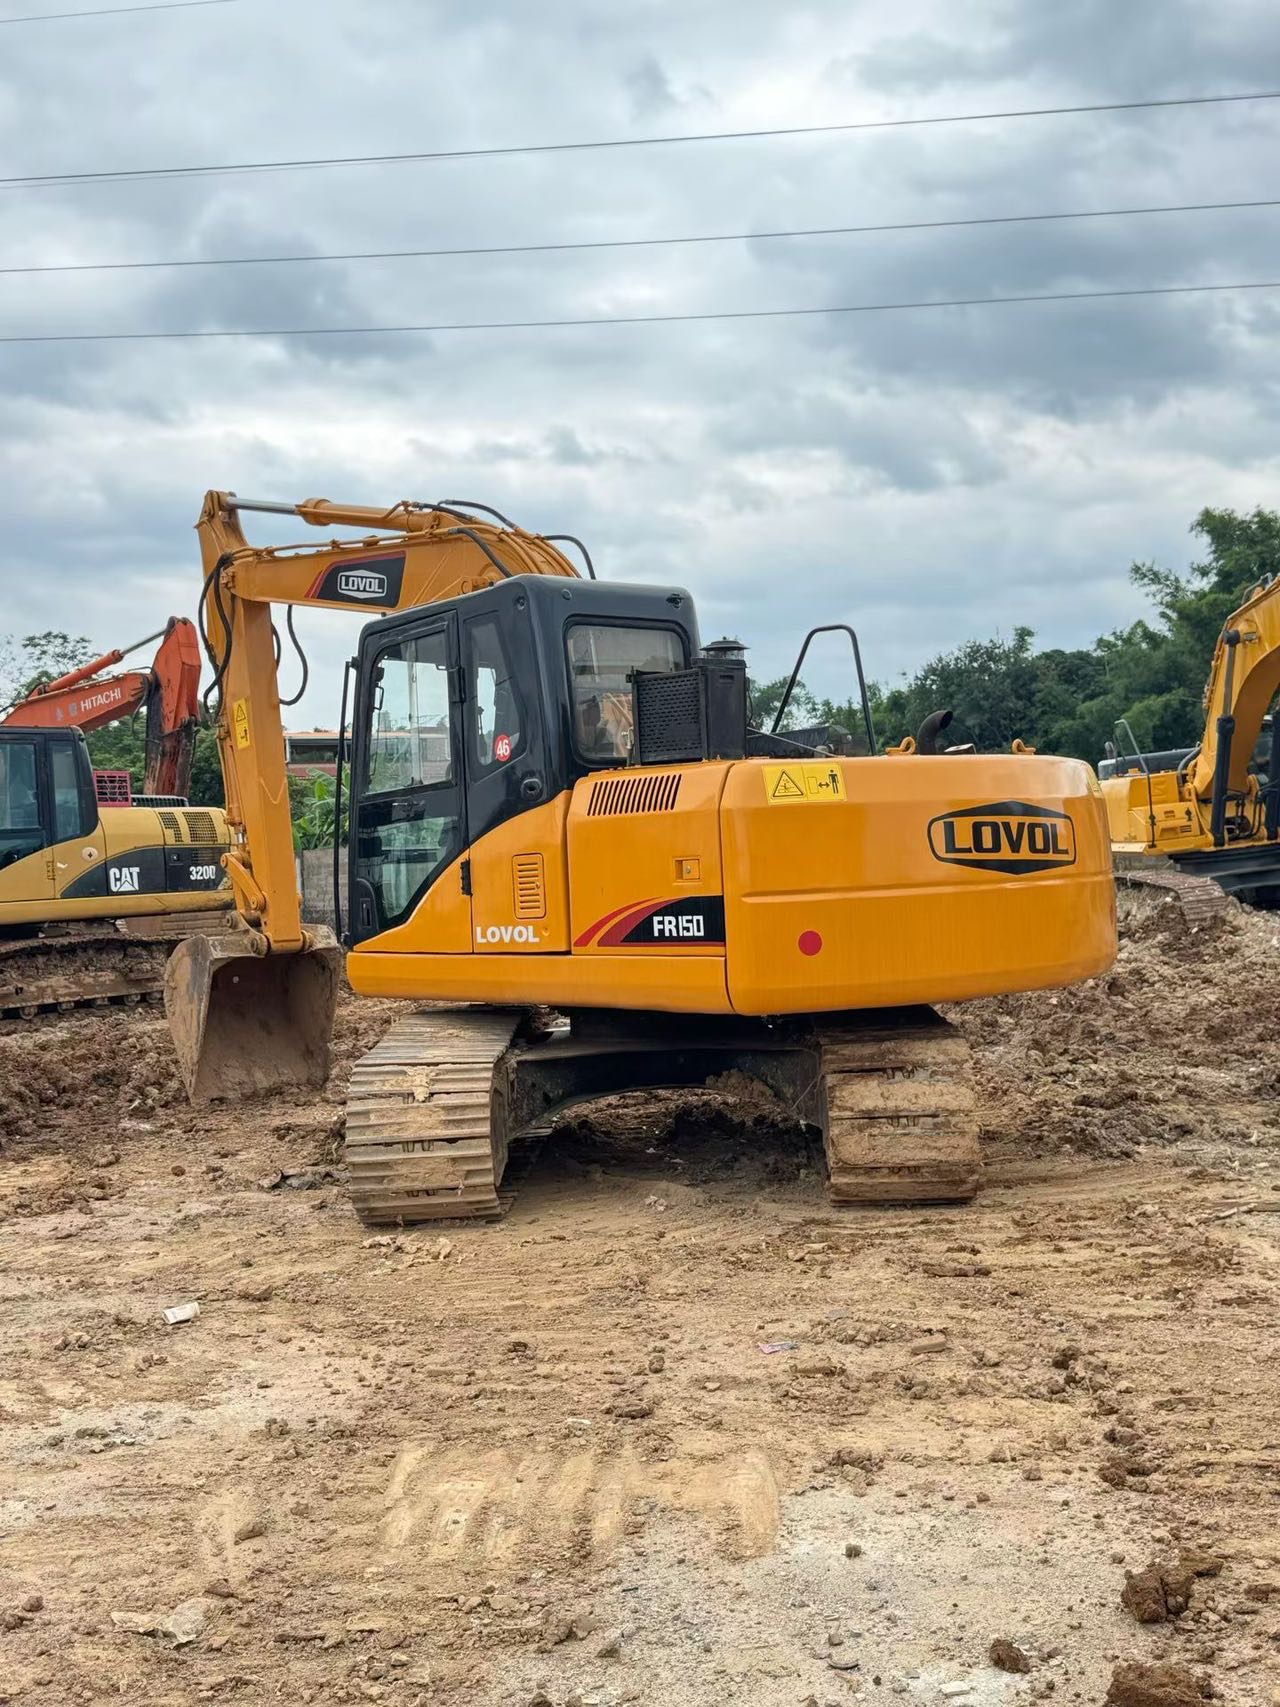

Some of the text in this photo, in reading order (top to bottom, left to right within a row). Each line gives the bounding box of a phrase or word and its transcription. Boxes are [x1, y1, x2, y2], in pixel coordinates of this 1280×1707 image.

[341, 576, 383, 592] LOVOL
[80, 688, 122, 712] HITACHI
[497, 739, 510, 756] 46
[943, 821, 1069, 855] LOVOL
[109, 867, 140, 892] CAT
[476, 926, 540, 944] LOVOL
[653, 915, 704, 937] FR150
